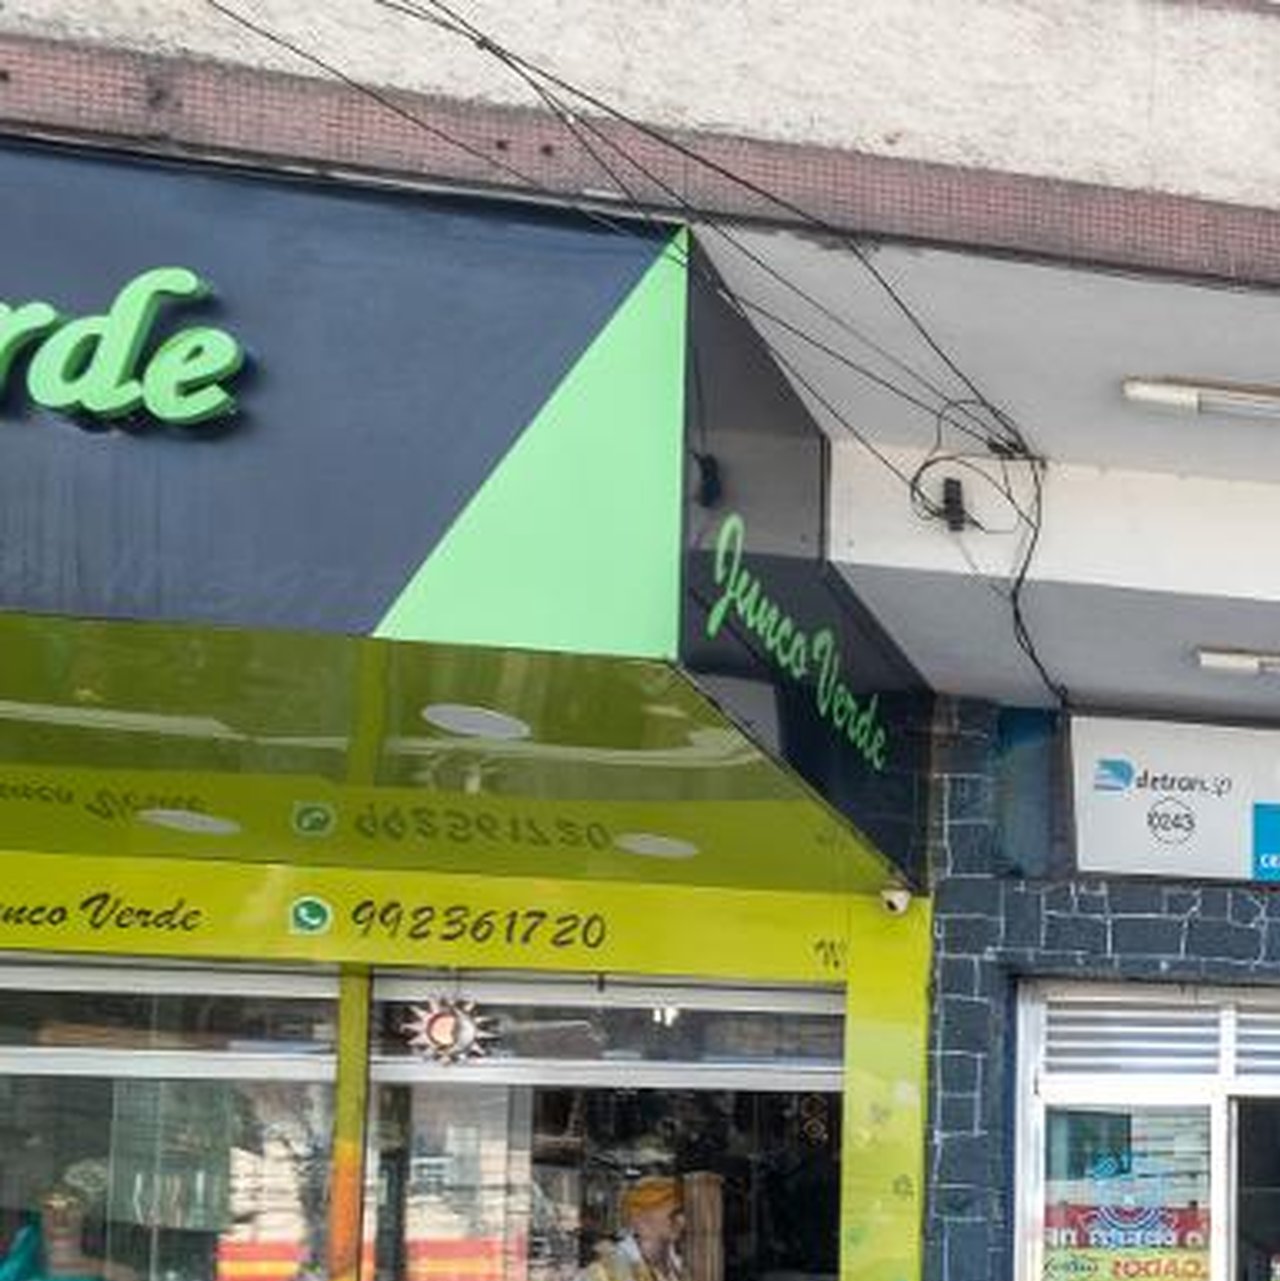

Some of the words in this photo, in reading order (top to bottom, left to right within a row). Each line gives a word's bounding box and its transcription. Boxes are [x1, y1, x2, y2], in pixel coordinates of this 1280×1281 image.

[813, 630, 886, 769] Verde
[80, 892, 201, 931] Verde
[352, 900, 606, 948] 992361720
